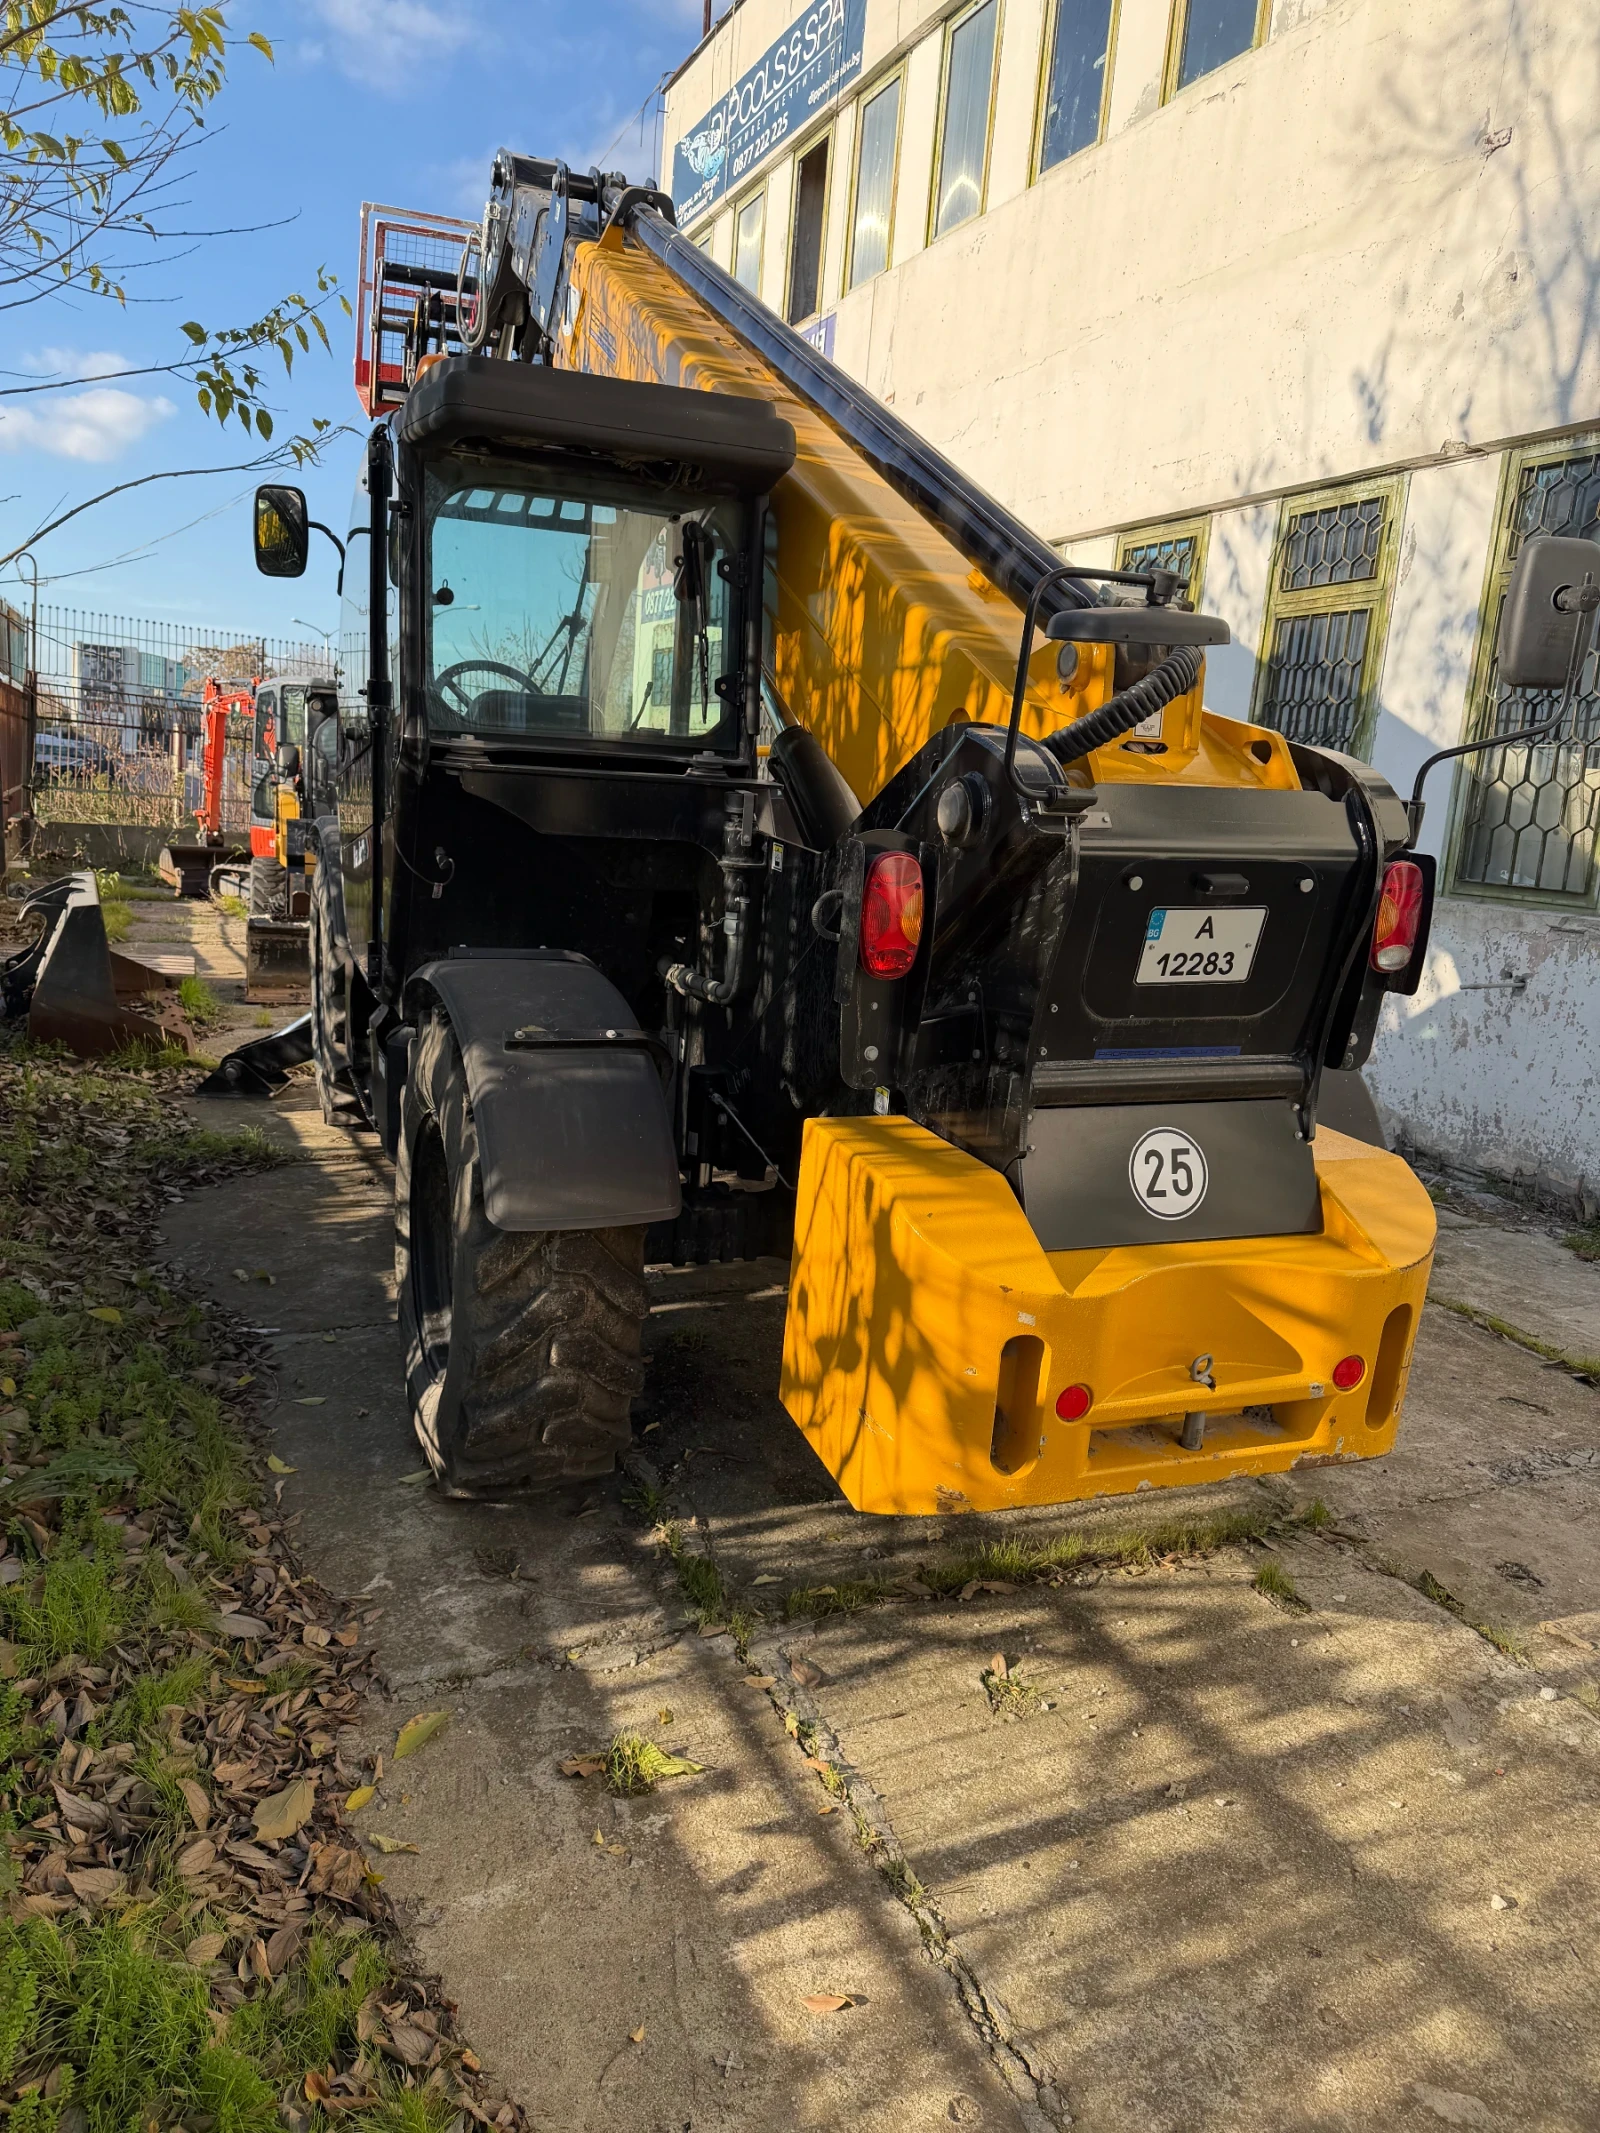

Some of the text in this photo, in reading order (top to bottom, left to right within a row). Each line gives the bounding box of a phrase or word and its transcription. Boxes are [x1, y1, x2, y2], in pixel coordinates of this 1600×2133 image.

[733, 111, 788, 177] 0877 222 225
[645, 589, 664, 615] 0877
[1148, 929, 1160, 937] BG
[1194, 915, 1214, 939] A
[1156, 951, 1235, 977] 12283
[1097, 1047, 1238, 1057] PROFESSIONAL SOLUTIONS
[1143, 1147, 1194, 1199] 25
